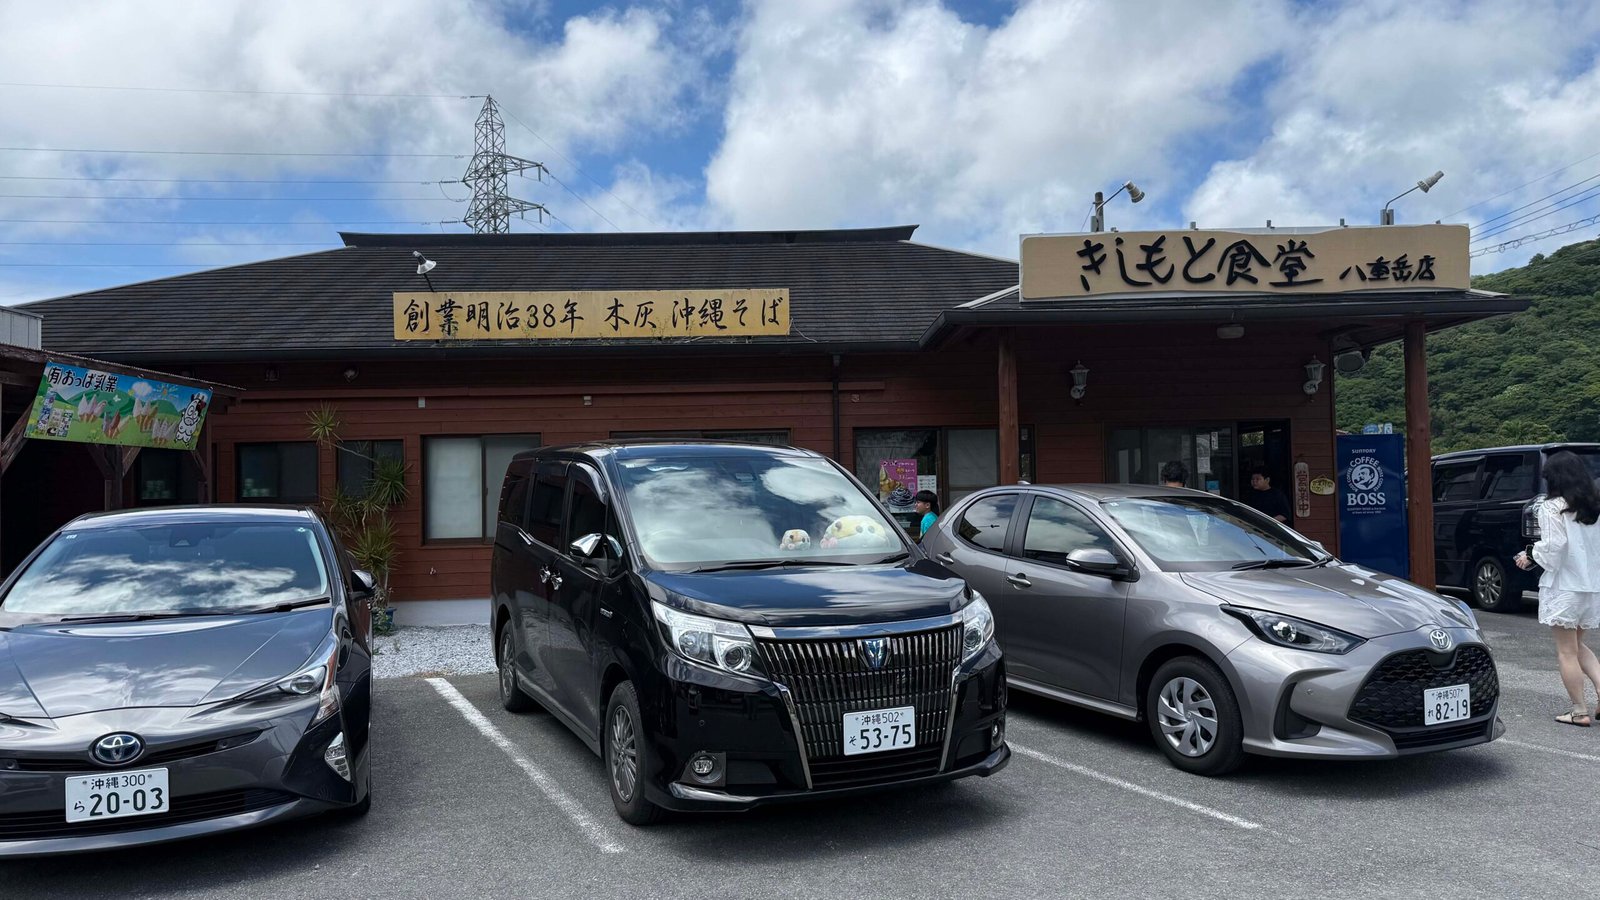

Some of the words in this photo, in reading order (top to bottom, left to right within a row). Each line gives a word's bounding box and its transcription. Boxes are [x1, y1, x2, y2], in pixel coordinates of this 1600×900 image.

[1075, 235, 1324, 292] きしもと食堂
[1339, 253, 1436, 282] 八重岳店
[403, 298, 584, 336] 創業明治38年
[603, 298, 658, 332] 木灰
[671, 297, 784, 332] 沖縄そば
[1349, 456, 1380, 468] COFFEE
[1346, 492, 1386, 506] BOSS
[861, 711, 900, 726] 沖縄502
[1435, 699, 1468, 721] 82-19
[849, 735, 857, 746] そ
[860, 723, 912, 750] 53-75
[91, 774, 146, 790] 沖縄300
[73, 801, 85, 813] ら
[89, 787, 164, 817] 20-03
